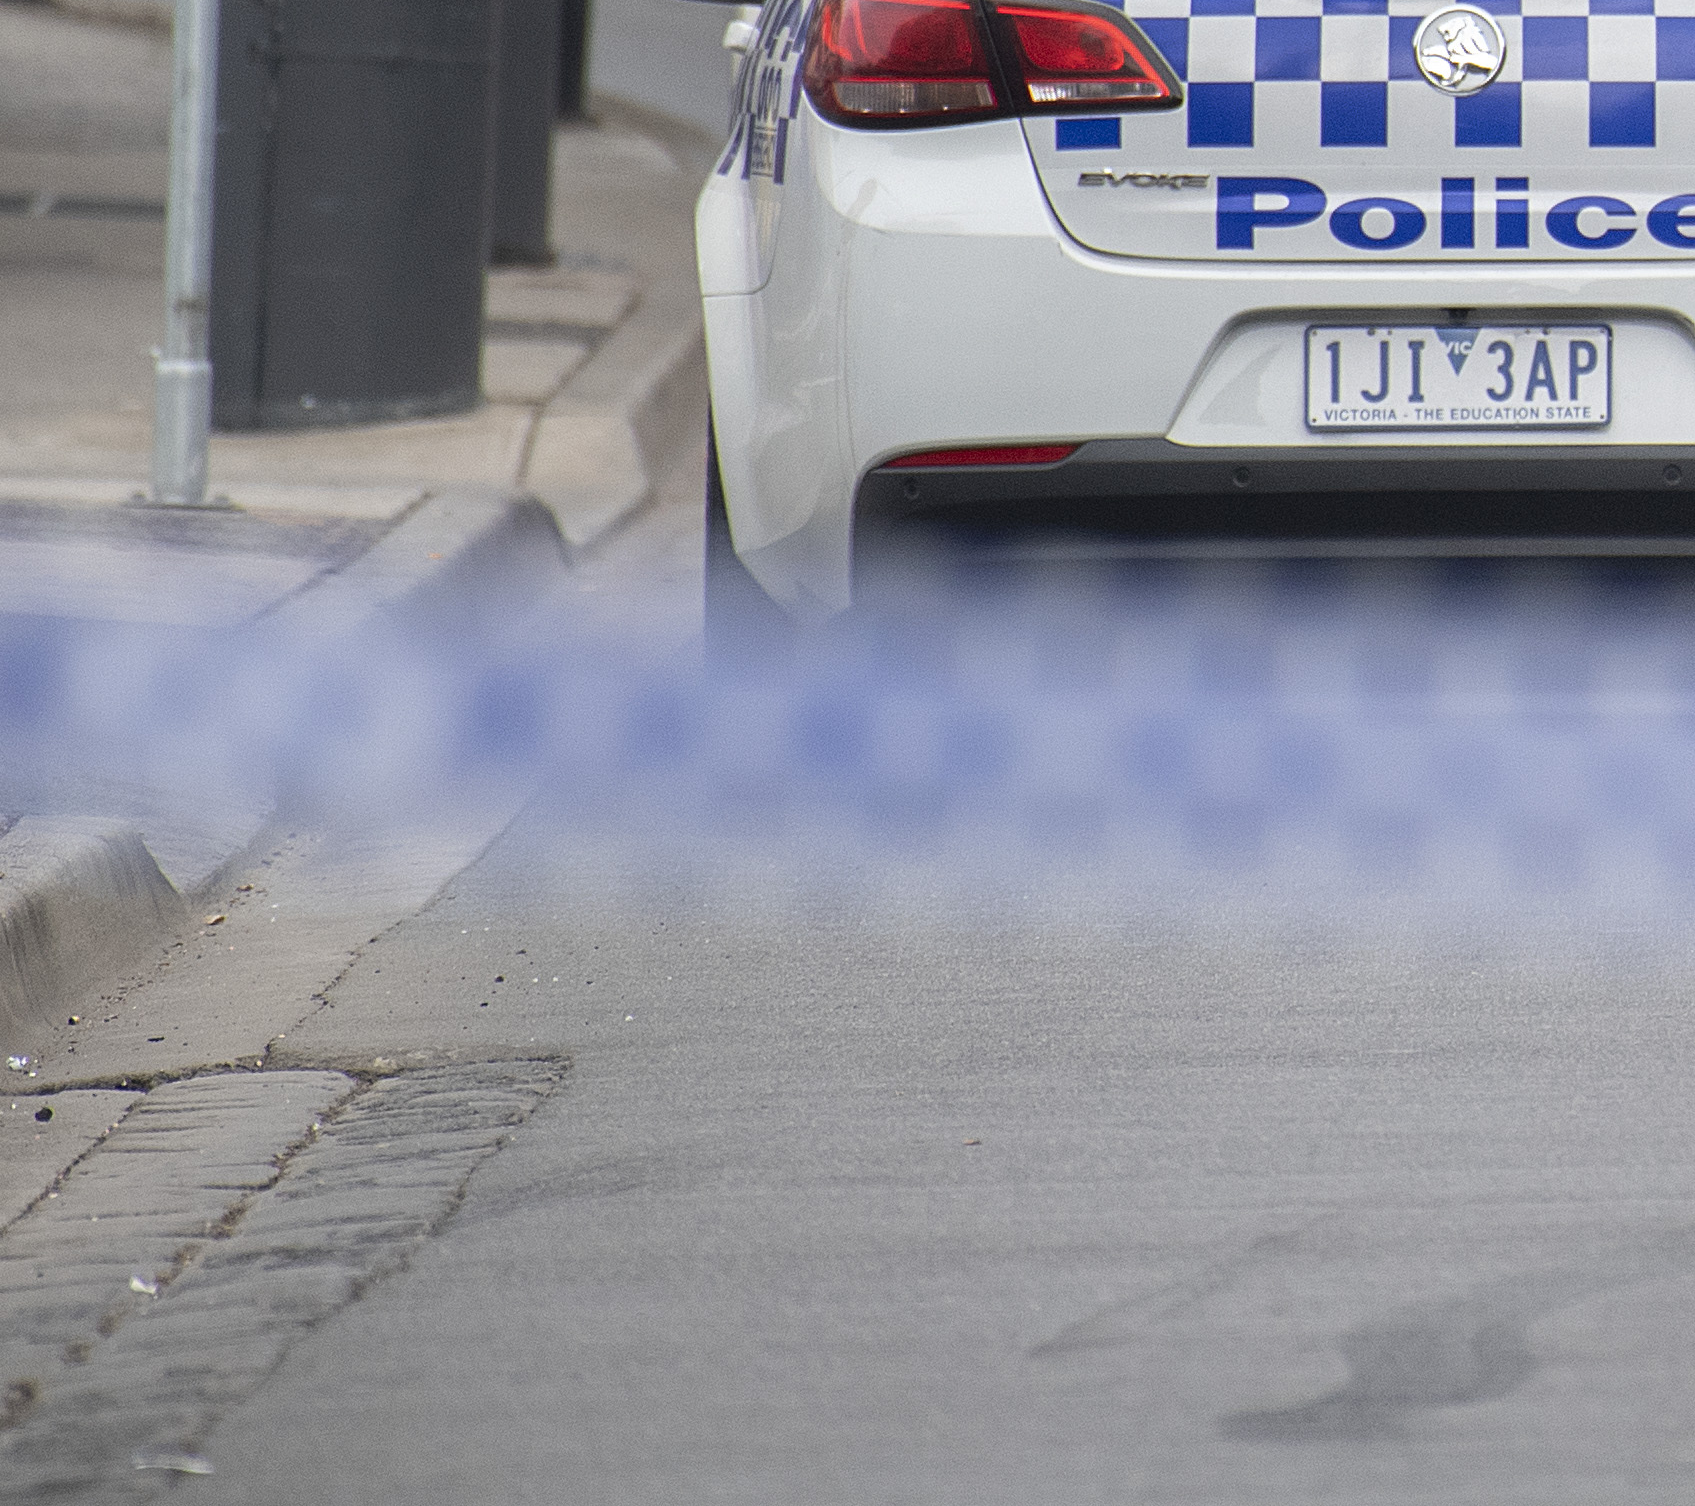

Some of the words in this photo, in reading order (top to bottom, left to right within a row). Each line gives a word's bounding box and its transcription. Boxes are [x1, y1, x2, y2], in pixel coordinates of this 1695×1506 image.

[1078, 173, 1210, 191] EVOKE
[1485, 339, 1599, 402] 3AP
[1324, 408, 1397, 422] VICTORIA
[1415, 408, 1444, 421] THE
[1450, 407, 1543, 421] EDUCATION
[1545, 406, 1592, 420] STATE
